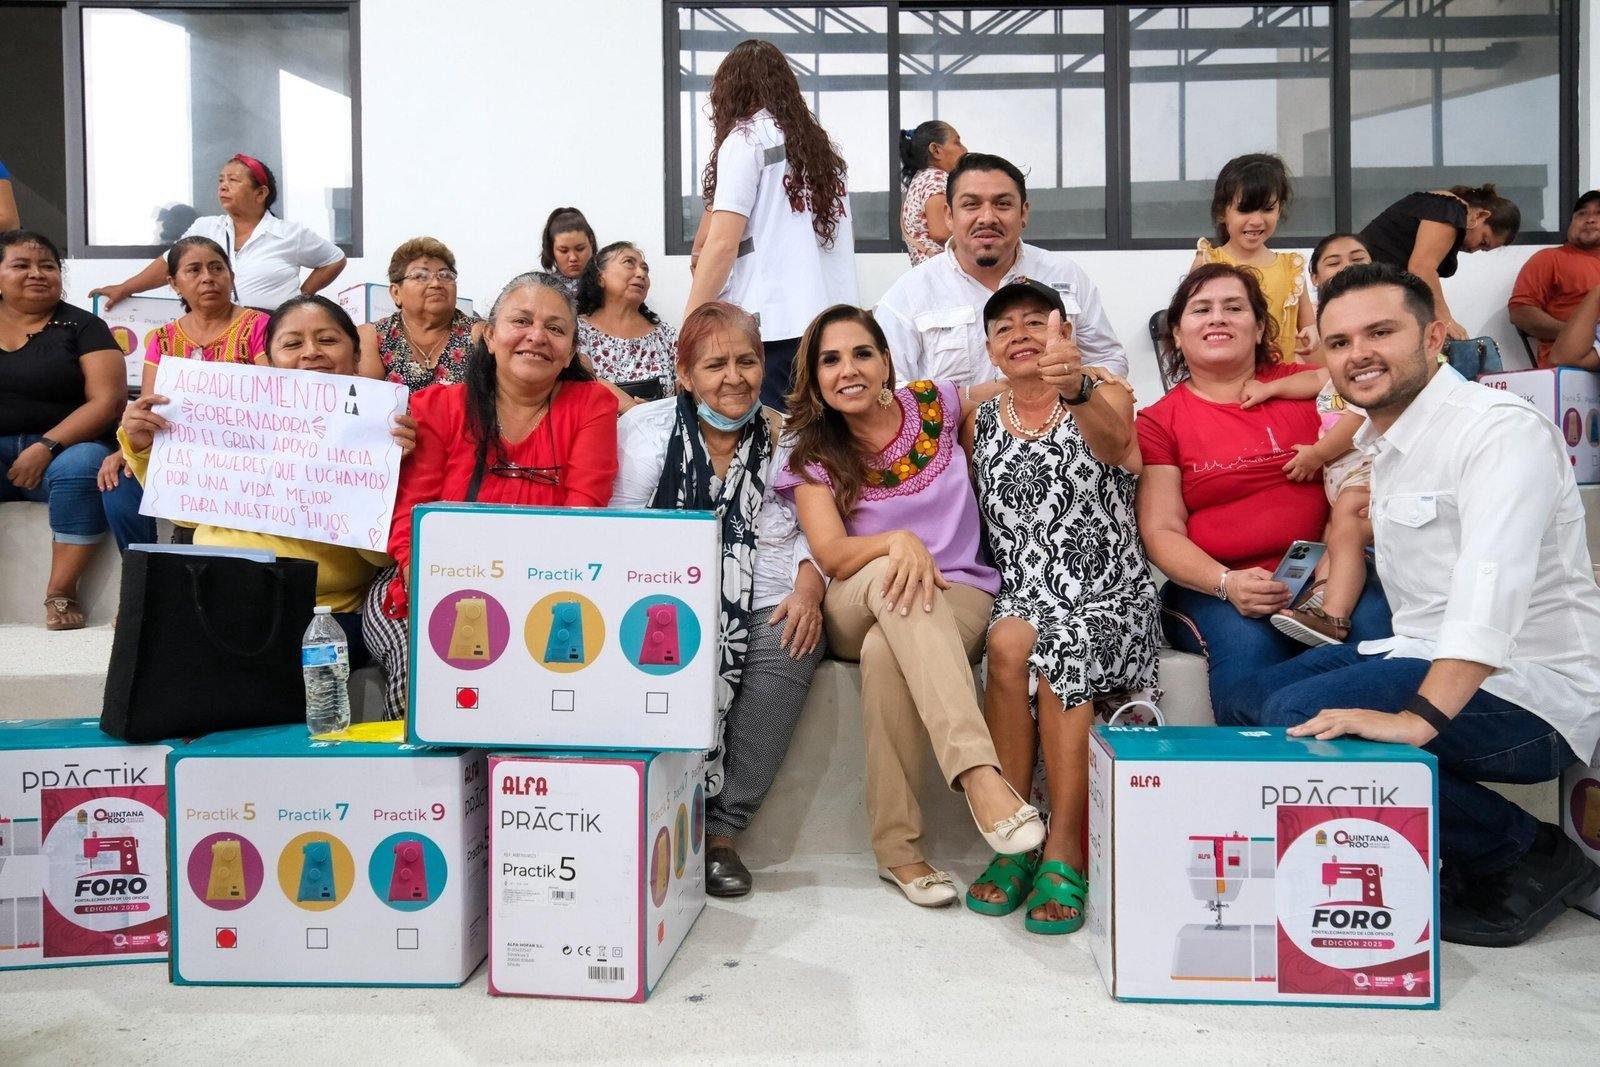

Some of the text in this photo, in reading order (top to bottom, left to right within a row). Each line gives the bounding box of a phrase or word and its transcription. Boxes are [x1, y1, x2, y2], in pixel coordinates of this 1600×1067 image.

[174, 370, 357, 412] AGRADECIMIENTO A
[344, 402, 360, 416] LA
[194, 404, 311, 435] GOBERNADORA
[201, 428, 217, 447] EL
[222, 430, 265, 450] GRAN
[272, 437, 318, 459] APOYO
[327, 447, 372, 466] HACIA
[167, 449, 386, 490] LAS MUJERES QUE LUCHAMOS
[166, 470, 332, 505] POR UNA VIDA MEJOR
[180, 494, 350, 535] PARA NUESTROS HIJOS
[430, 560, 505, 579] Practik 5
[527, 563, 603, 582] Practik 7
[627, 566, 702, 584] Practik 9
[502, 775, 548, 796] ALFA
[1130, 775, 1161, 788] ALFA
[94, 808, 144, 821] QUINTANA
[186, 803, 256, 821] Practik 5
[278, 803, 350, 821] Practik 7
[373, 803, 446, 821] Practik 9
[1334, 830, 1390, 845] QUINTANA
[503, 856, 576, 881] Practik 5
[74, 877, 147, 897] FORO
[85, 904, 118, 912] EDICIÓN
[1312, 909, 1392, 930] FORO
[1322, 939, 1360, 947] EDICIÓN
